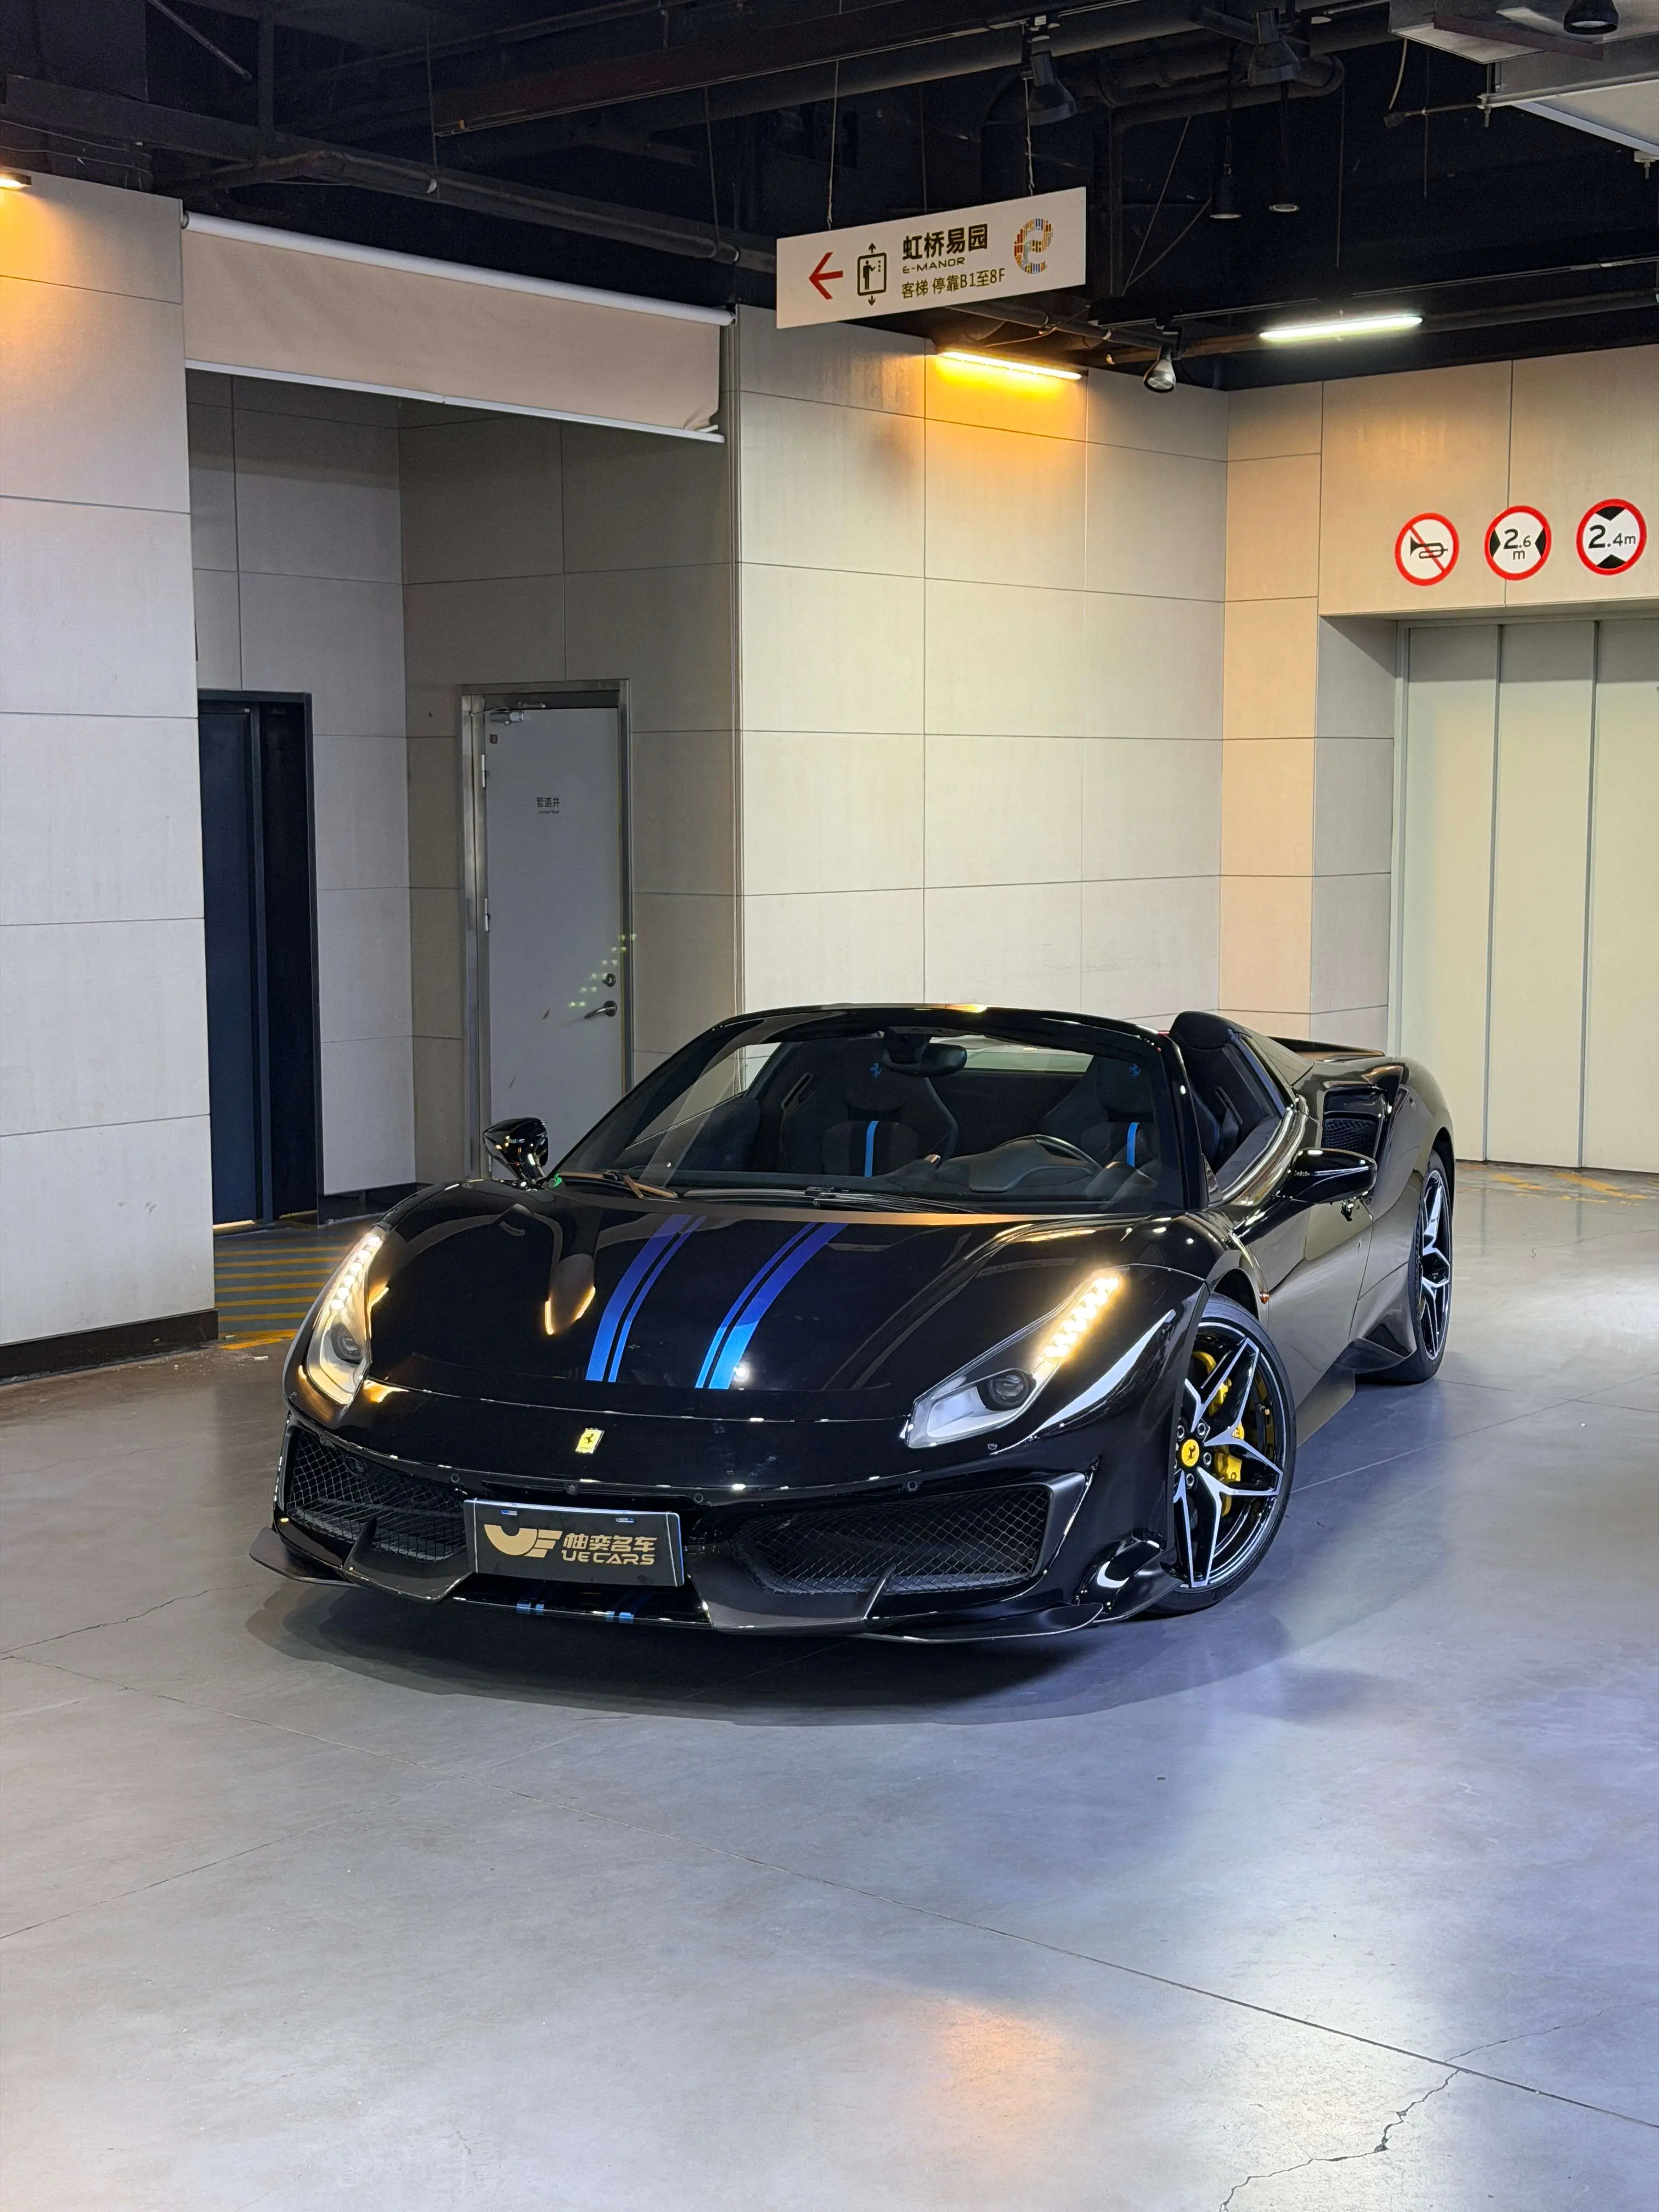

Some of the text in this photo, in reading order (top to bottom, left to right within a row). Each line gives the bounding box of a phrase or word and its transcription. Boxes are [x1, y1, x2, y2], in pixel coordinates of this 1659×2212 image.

[902, 223, 988, 260] 虹桥易园
[901, 268, 1005, 299] 客梯 停靠B1至8F
[1503, 528, 1532, 549] 2.6
[1513, 550, 1526, 560] m
